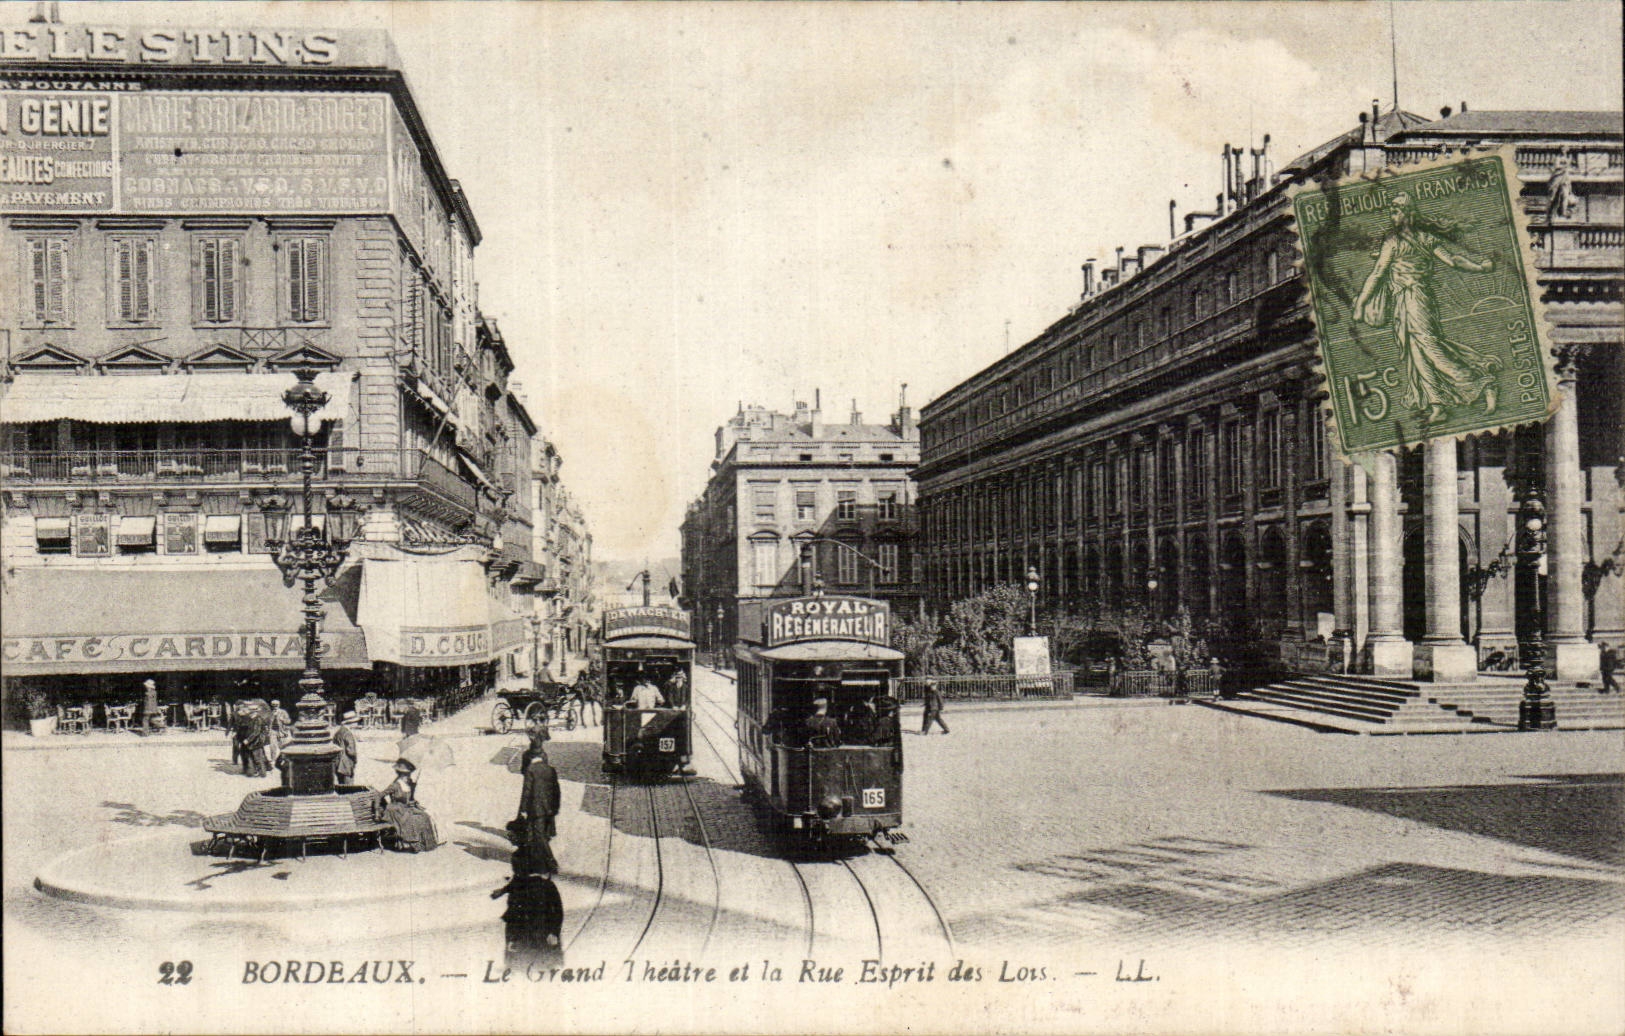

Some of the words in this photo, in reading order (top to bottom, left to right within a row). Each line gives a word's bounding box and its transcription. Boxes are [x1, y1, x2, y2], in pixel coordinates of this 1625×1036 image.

[0, 27, 338, 63] ELESTINS
[121, 96, 192, 133] MARIE
[196, 96, 295, 133] BRIZARD
[307, 97, 384, 134] ROGER
[1415, 171, 1499, 200] FRANÇAISE
[1507, 319, 1541, 404] POSTES
[791, 601, 868, 615] ROYAL
[659, 739, 674, 750] 157
[864, 791, 885, 806] 165
